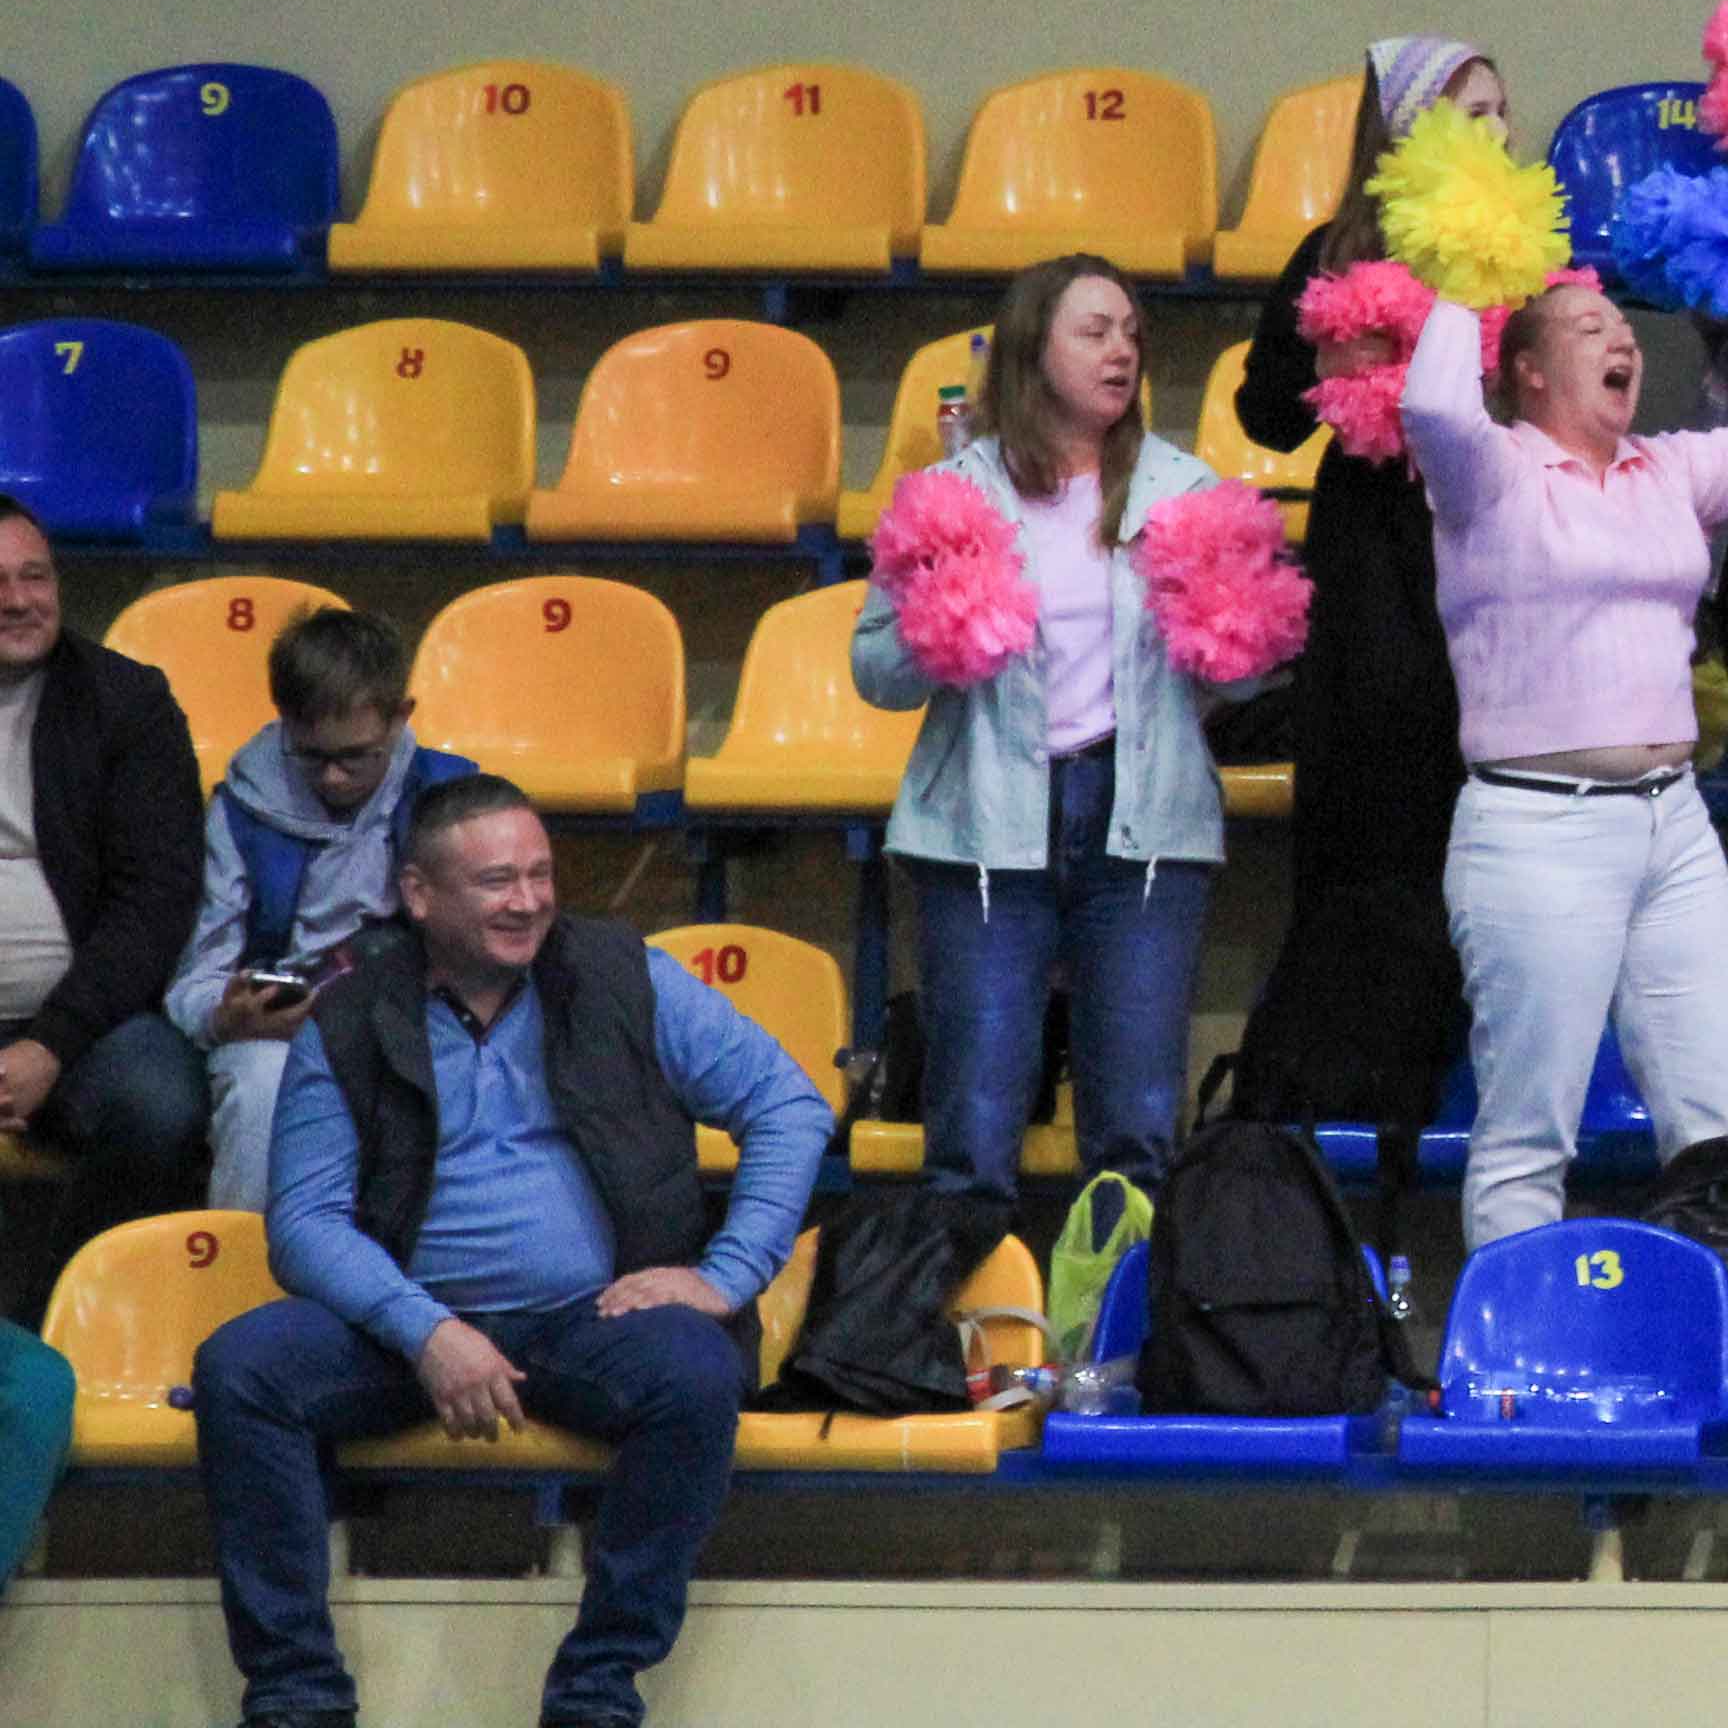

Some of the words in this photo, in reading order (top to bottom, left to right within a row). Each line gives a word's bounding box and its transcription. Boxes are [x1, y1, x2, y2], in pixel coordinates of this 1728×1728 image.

[201, 82, 231, 116] 9
[484, 82, 531, 116] 10
[783, 82, 821, 116] 11
[1084, 88, 1126, 121] 12
[1658, 99, 1697, 129] 14
[55, 341, 84, 374] 7
[703, 347, 731, 381] 9
[226, 597, 256, 633] 8
[542, 598, 573, 633] 9
[693, 944, 748, 986] 10
[185, 1230, 220, 1270] 9
[1576, 1249, 1624, 1290] 13
